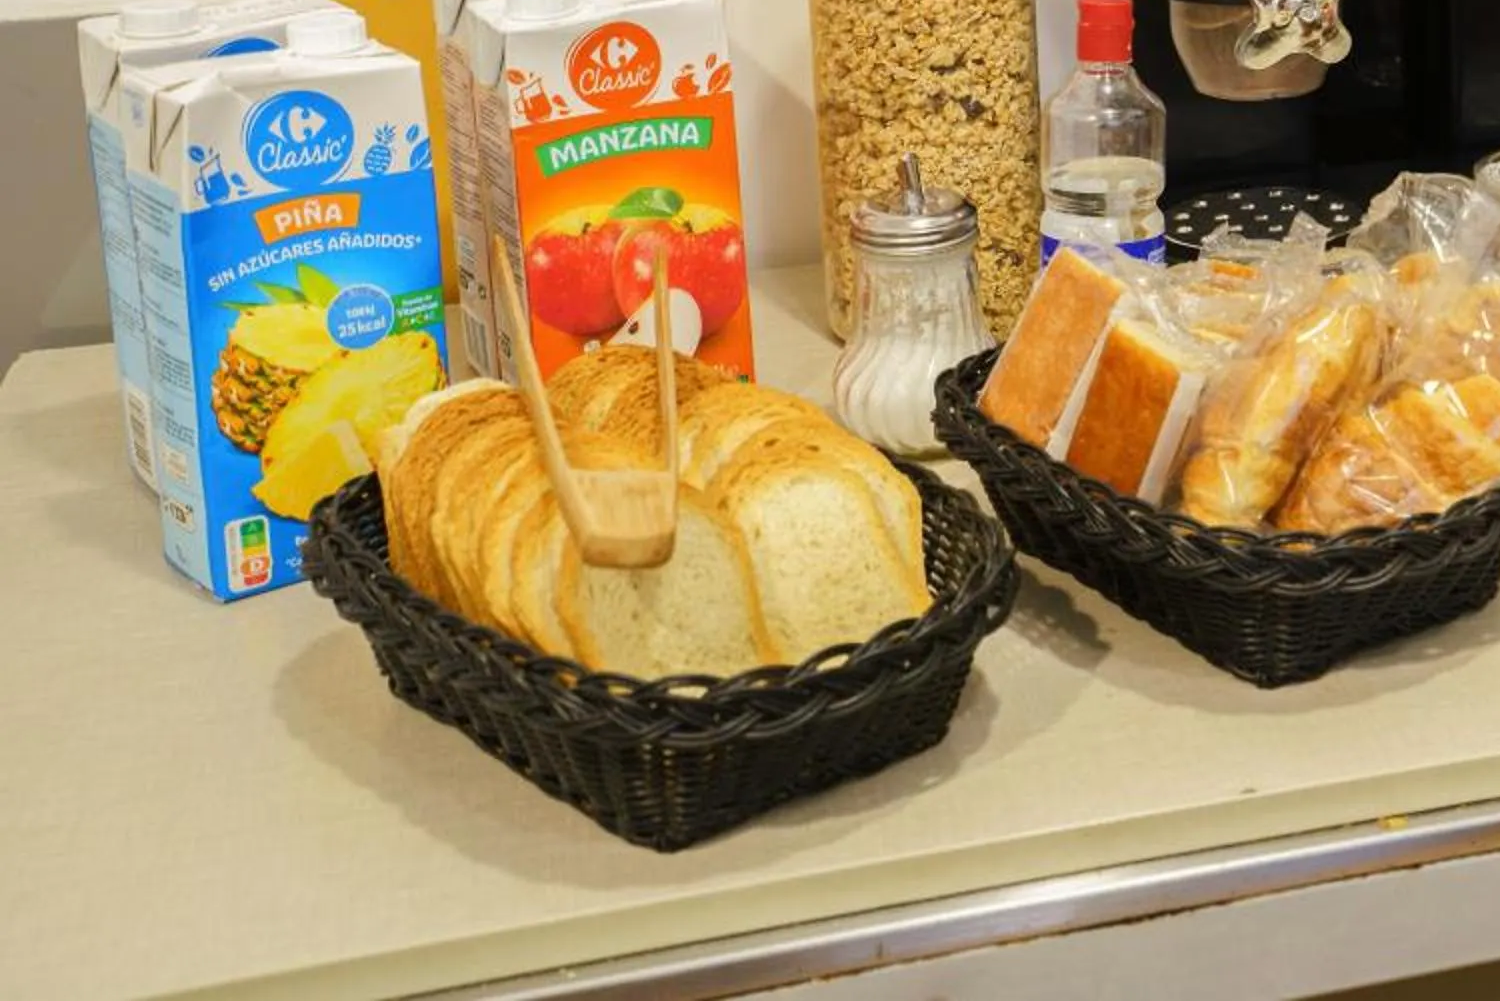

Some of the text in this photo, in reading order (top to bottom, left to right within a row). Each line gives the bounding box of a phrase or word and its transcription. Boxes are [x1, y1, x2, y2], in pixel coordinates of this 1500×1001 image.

[579, 66, 651, 96] Classic
[258, 137, 344, 172] Classic
[550, 121, 700, 170] MANZANA
[273, 198, 344, 233] PIÑA
[208, 268, 236, 292] SIN
[238, 238, 325, 278] AZÚCARES
[357, 314, 386, 334] kcal
